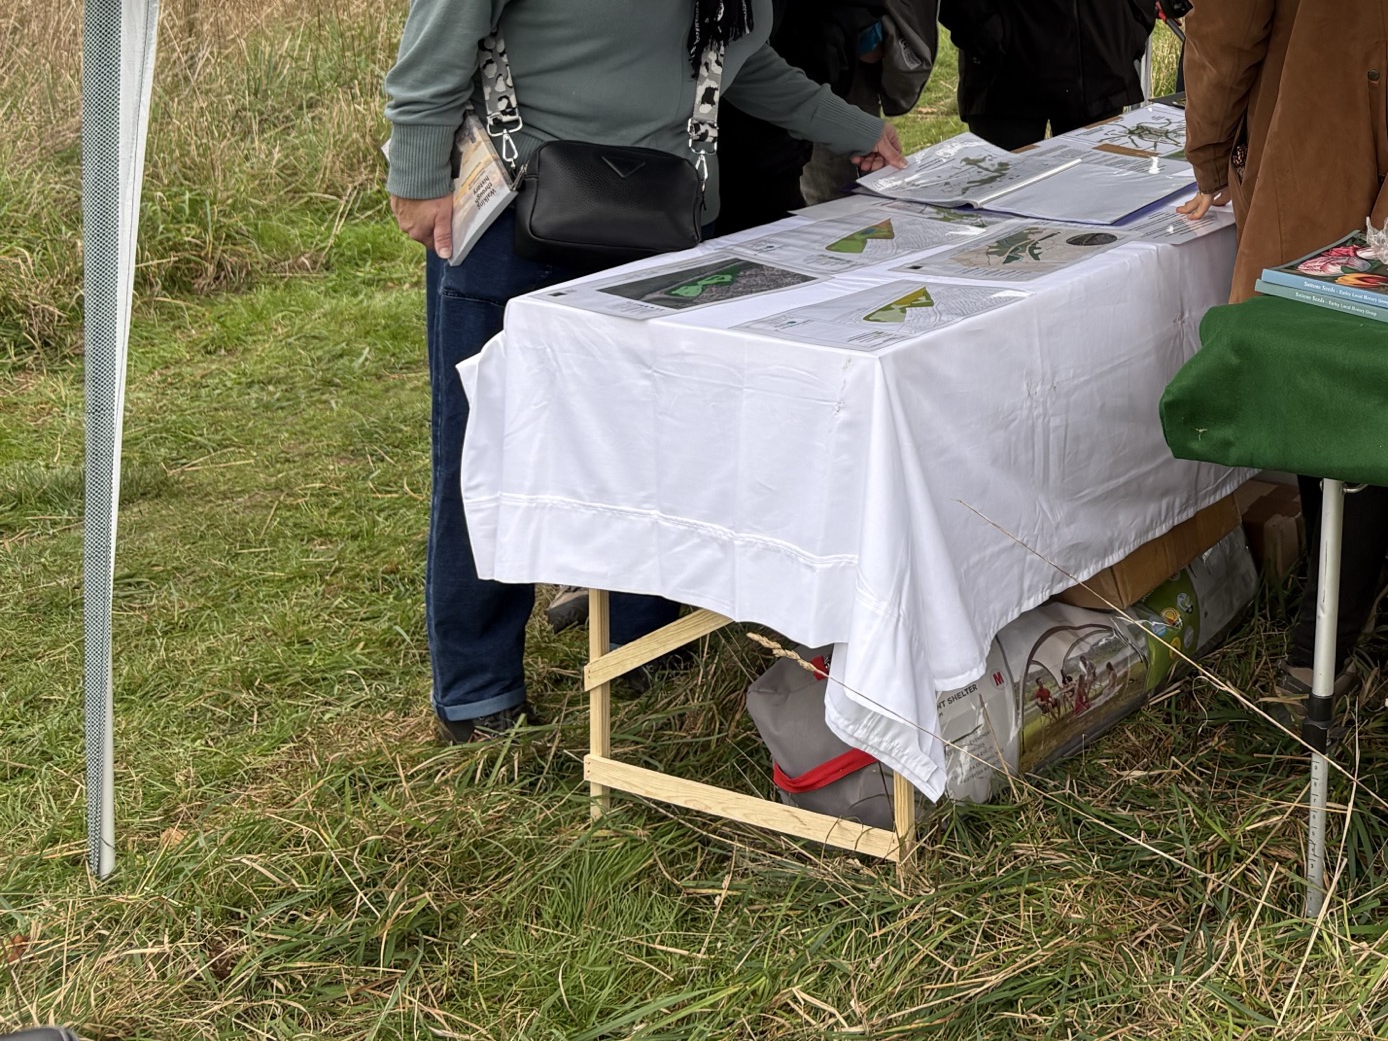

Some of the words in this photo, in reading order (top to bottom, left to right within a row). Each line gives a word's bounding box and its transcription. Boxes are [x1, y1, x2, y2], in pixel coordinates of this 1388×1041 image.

[473, 175, 490, 195] history
[475, 181, 493, 204] through
[477, 188, 497, 210] Walking
[992, 671, 1005, 687] M
[947, 683, 978, 705] SHELTER
